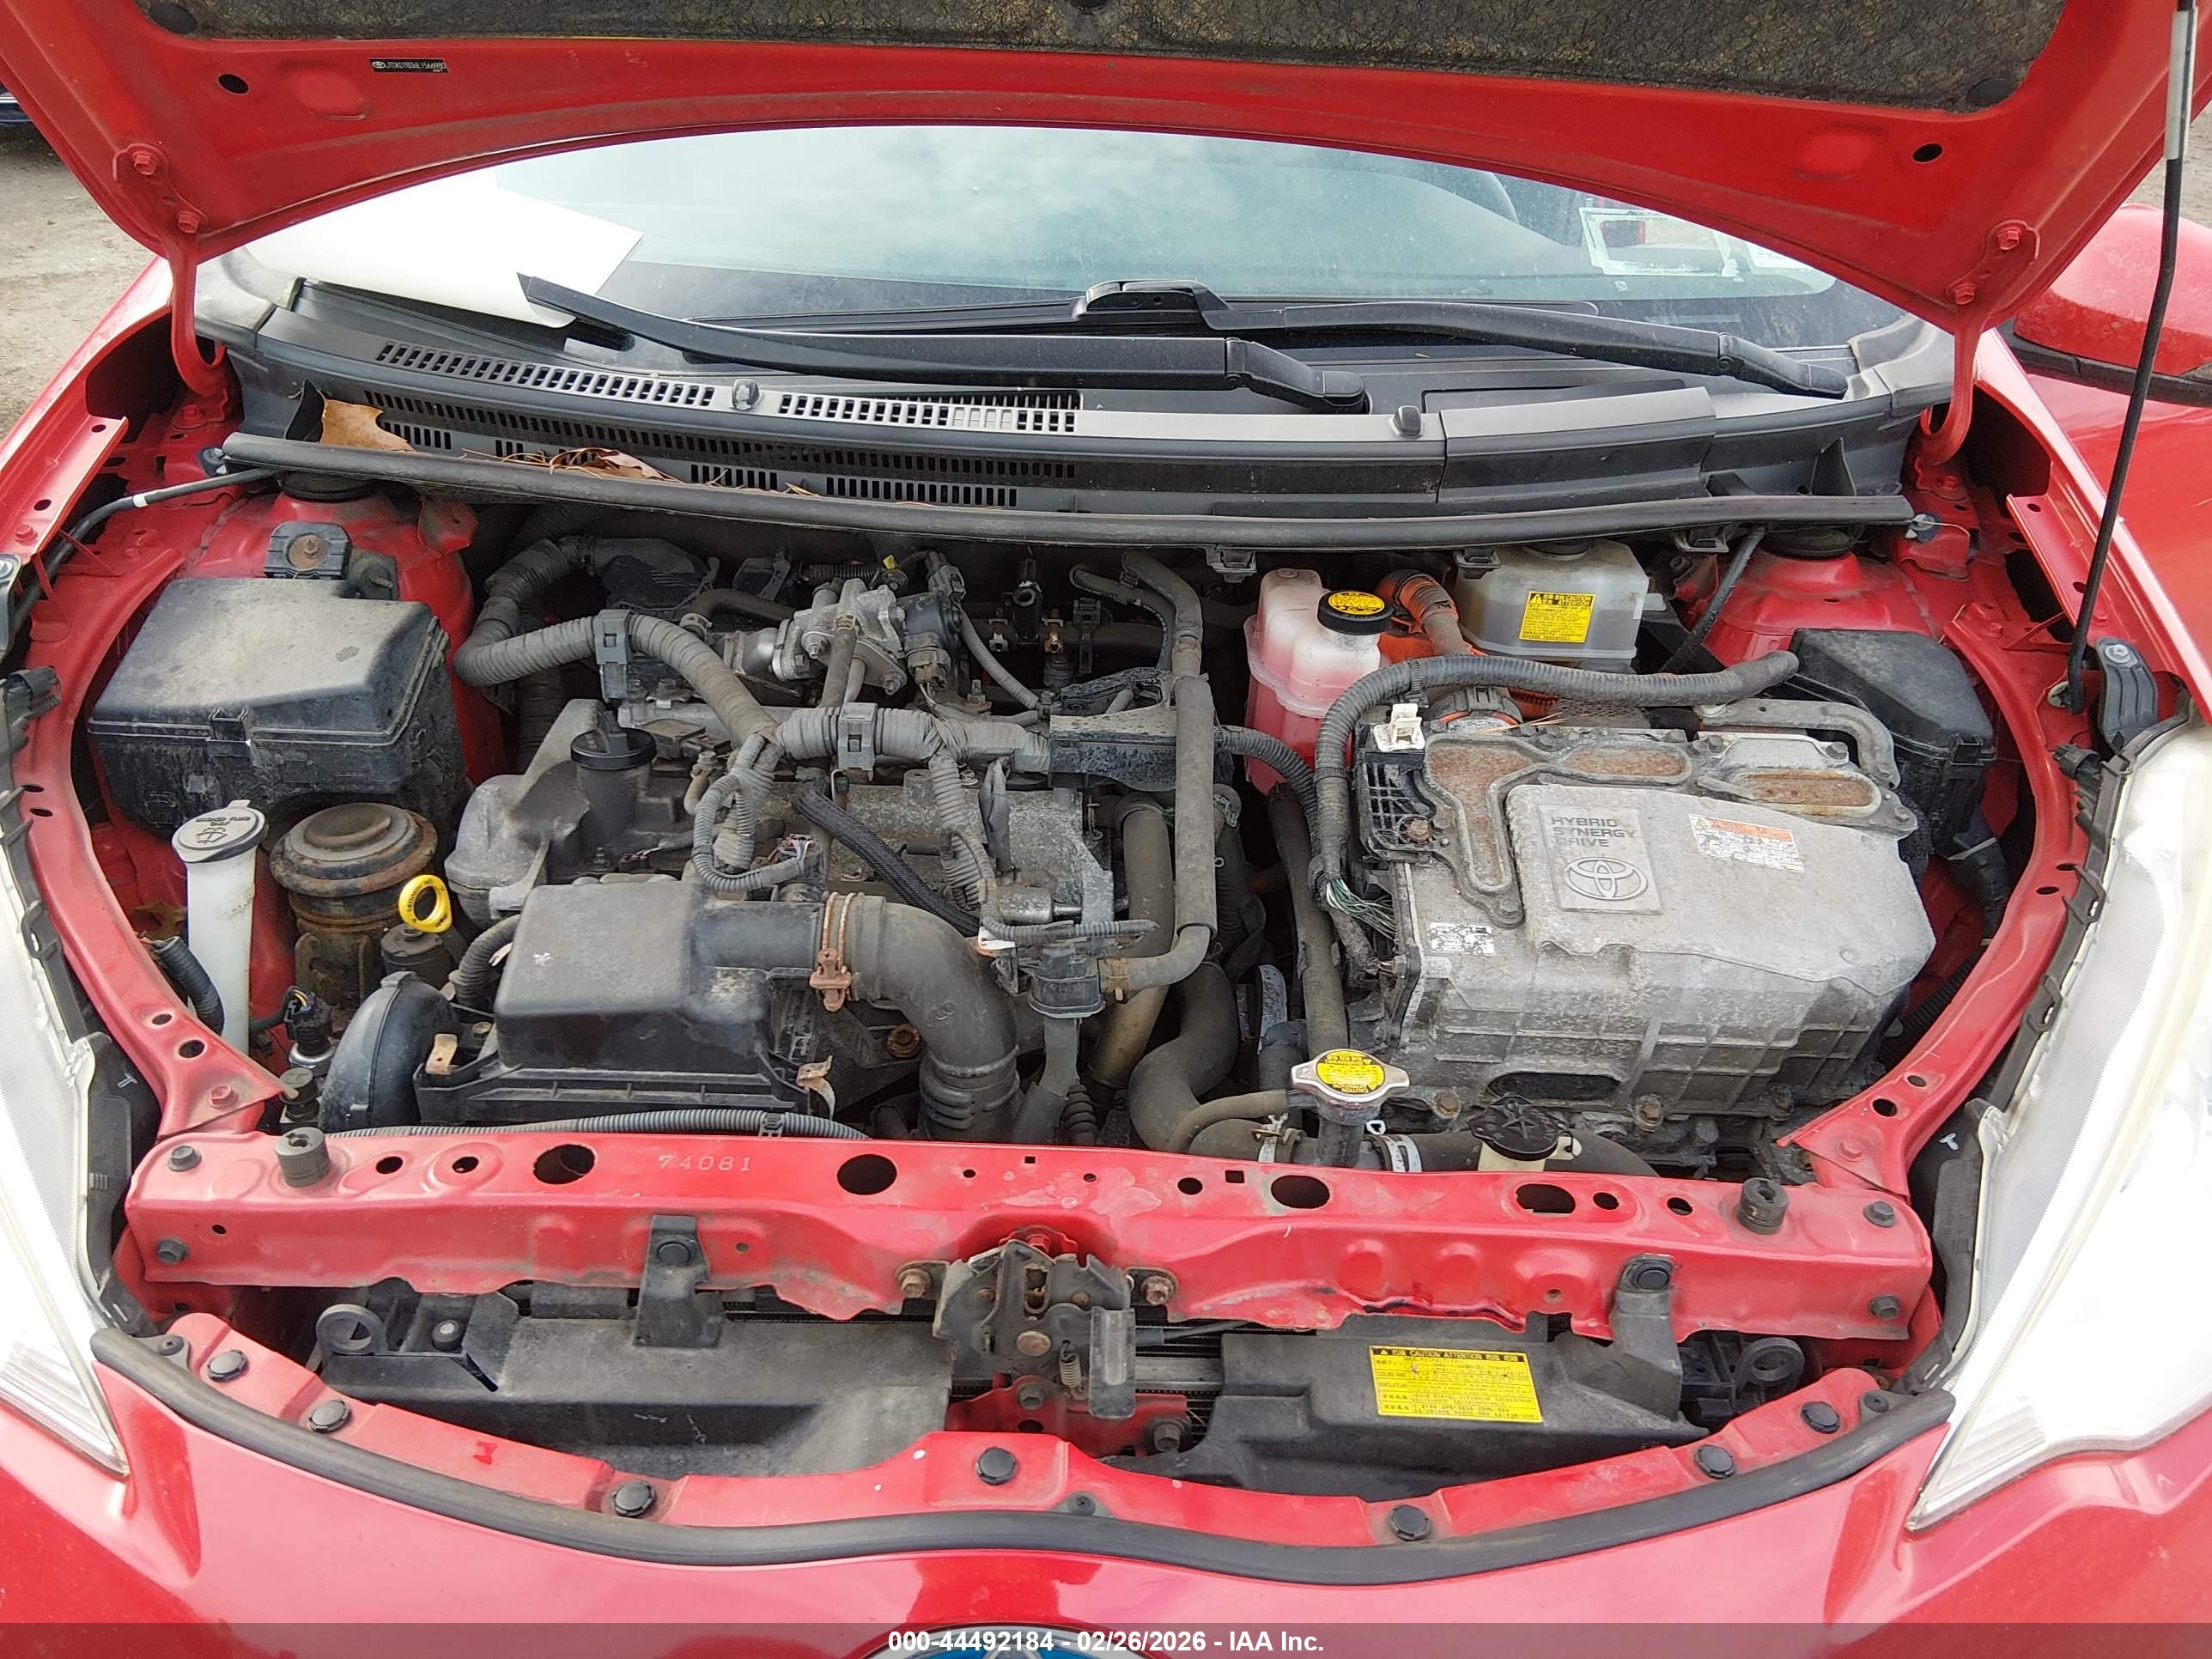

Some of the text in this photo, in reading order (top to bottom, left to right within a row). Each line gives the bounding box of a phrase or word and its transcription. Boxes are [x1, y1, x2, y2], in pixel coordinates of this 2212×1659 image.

[1551, 817, 1620, 828] HYBRID
[1552, 826, 1635, 839] SYNERGY
[658, 1154, 752, 1172] 74081
[1443, 1352, 1483, 1361] ATTENTION
